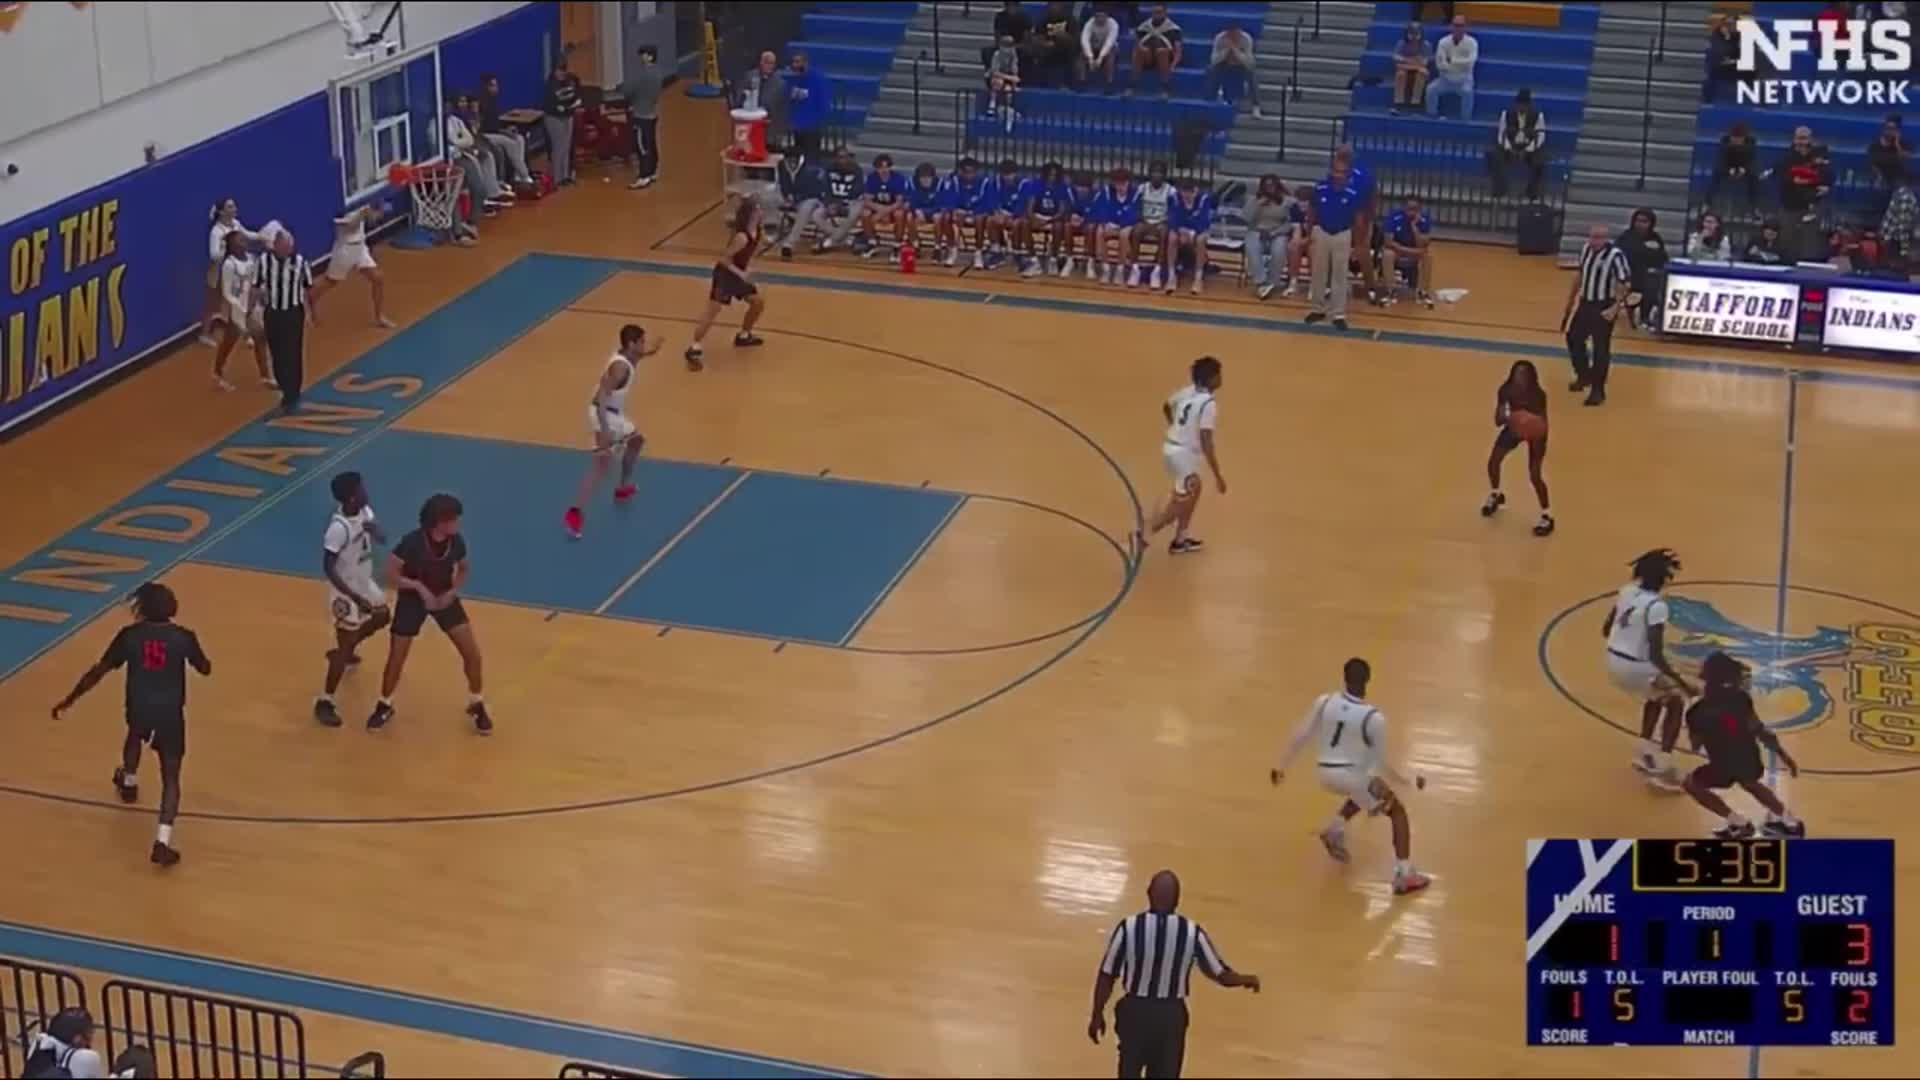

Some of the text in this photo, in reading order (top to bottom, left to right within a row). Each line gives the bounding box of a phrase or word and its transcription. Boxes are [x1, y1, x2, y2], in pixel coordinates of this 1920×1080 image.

[10, 199, 119, 295] OF THE
[1667, 289, 1795, 321] STAFFORD
[1828, 306, 1917, 331] INDIANS
[0, 263, 127, 404] IANS
[1668, 314, 1791, 339] HIGH SCHOOL
[0, 373, 424, 625] INDIANS
[1330, 720, 1345, 749] 1
